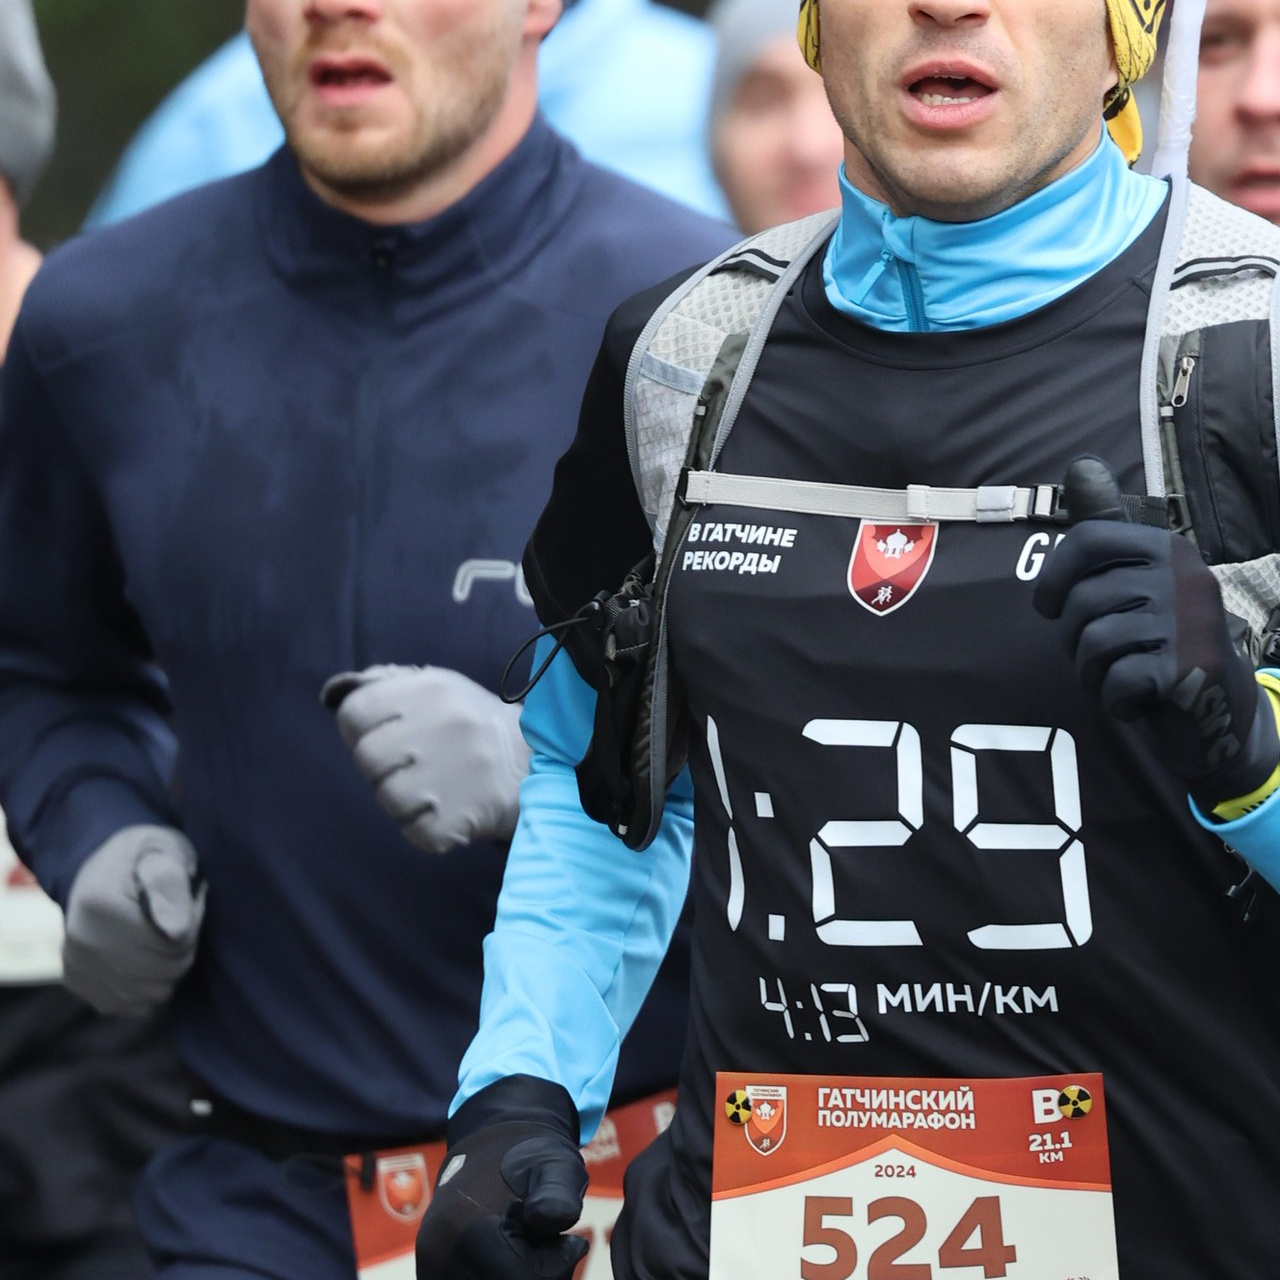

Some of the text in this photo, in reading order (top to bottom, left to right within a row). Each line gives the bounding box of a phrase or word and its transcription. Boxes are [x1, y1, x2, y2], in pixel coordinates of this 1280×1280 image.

[688, 523, 797, 548] В ГАТЧИНЕ
[682, 551, 781, 575] РЕКОРДЫ
[706, 714, 1094, 950] 1:29
[758, 977, 1060, 1043] 4:13 МИН/КМ
[817, 1085, 975, 1111] ГАТЧИНСКИЙ
[817, 1109, 977, 1130] ПОЛУМАРАФОН
[1028, 1131, 1073, 1152] 21.1
[1039, 1151, 1065, 1164] КМ
[874, 1164, 917, 1178] 2024
